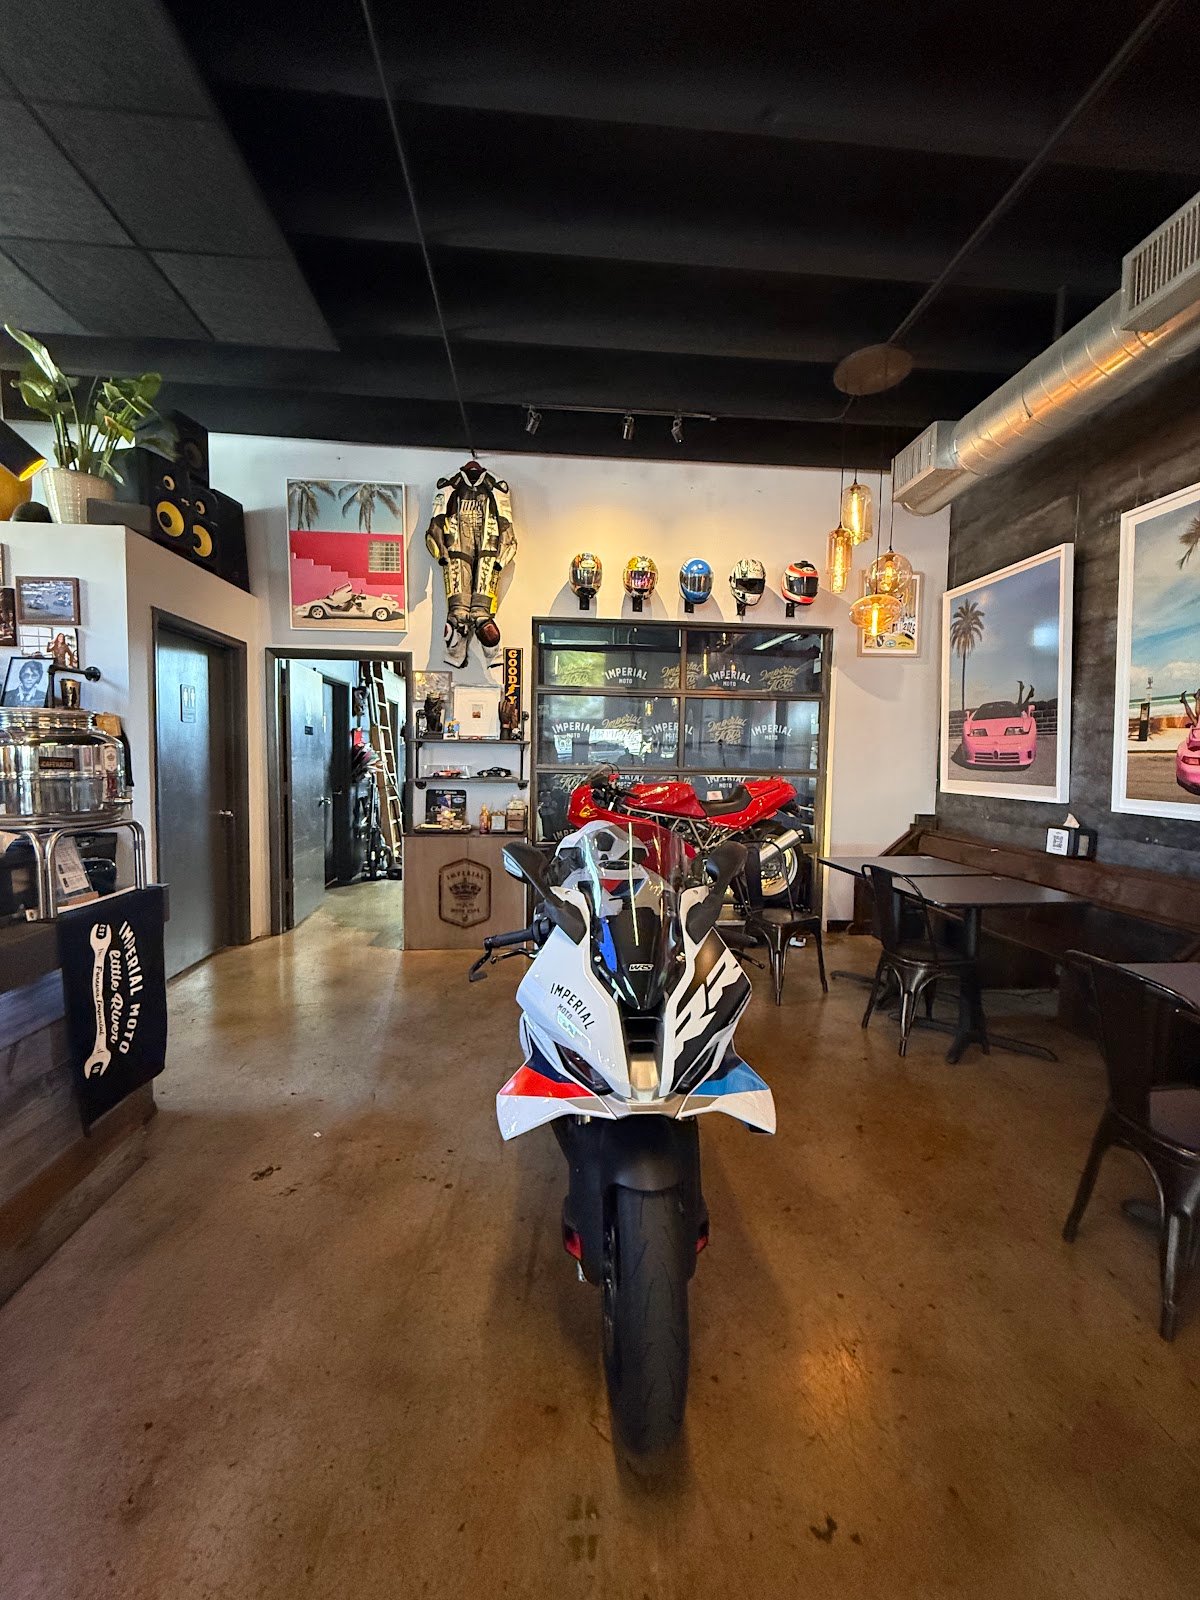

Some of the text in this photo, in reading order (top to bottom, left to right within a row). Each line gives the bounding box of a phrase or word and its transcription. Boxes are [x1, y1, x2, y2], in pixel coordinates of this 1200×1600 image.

[508, 649, 518, 705] GOODY
[605, 667, 648, 681] IMPERIAL
[709, 670, 752, 684] IMPERIAL
[751, 724, 793, 737] IMPERIAL
[119, 921, 143, 1054] IMPERIAL MOTO
[110, 992, 123, 1044] River
[550, 983, 595, 1030] IMPERIAL
[557, 1003, 573, 1020] MOTO
